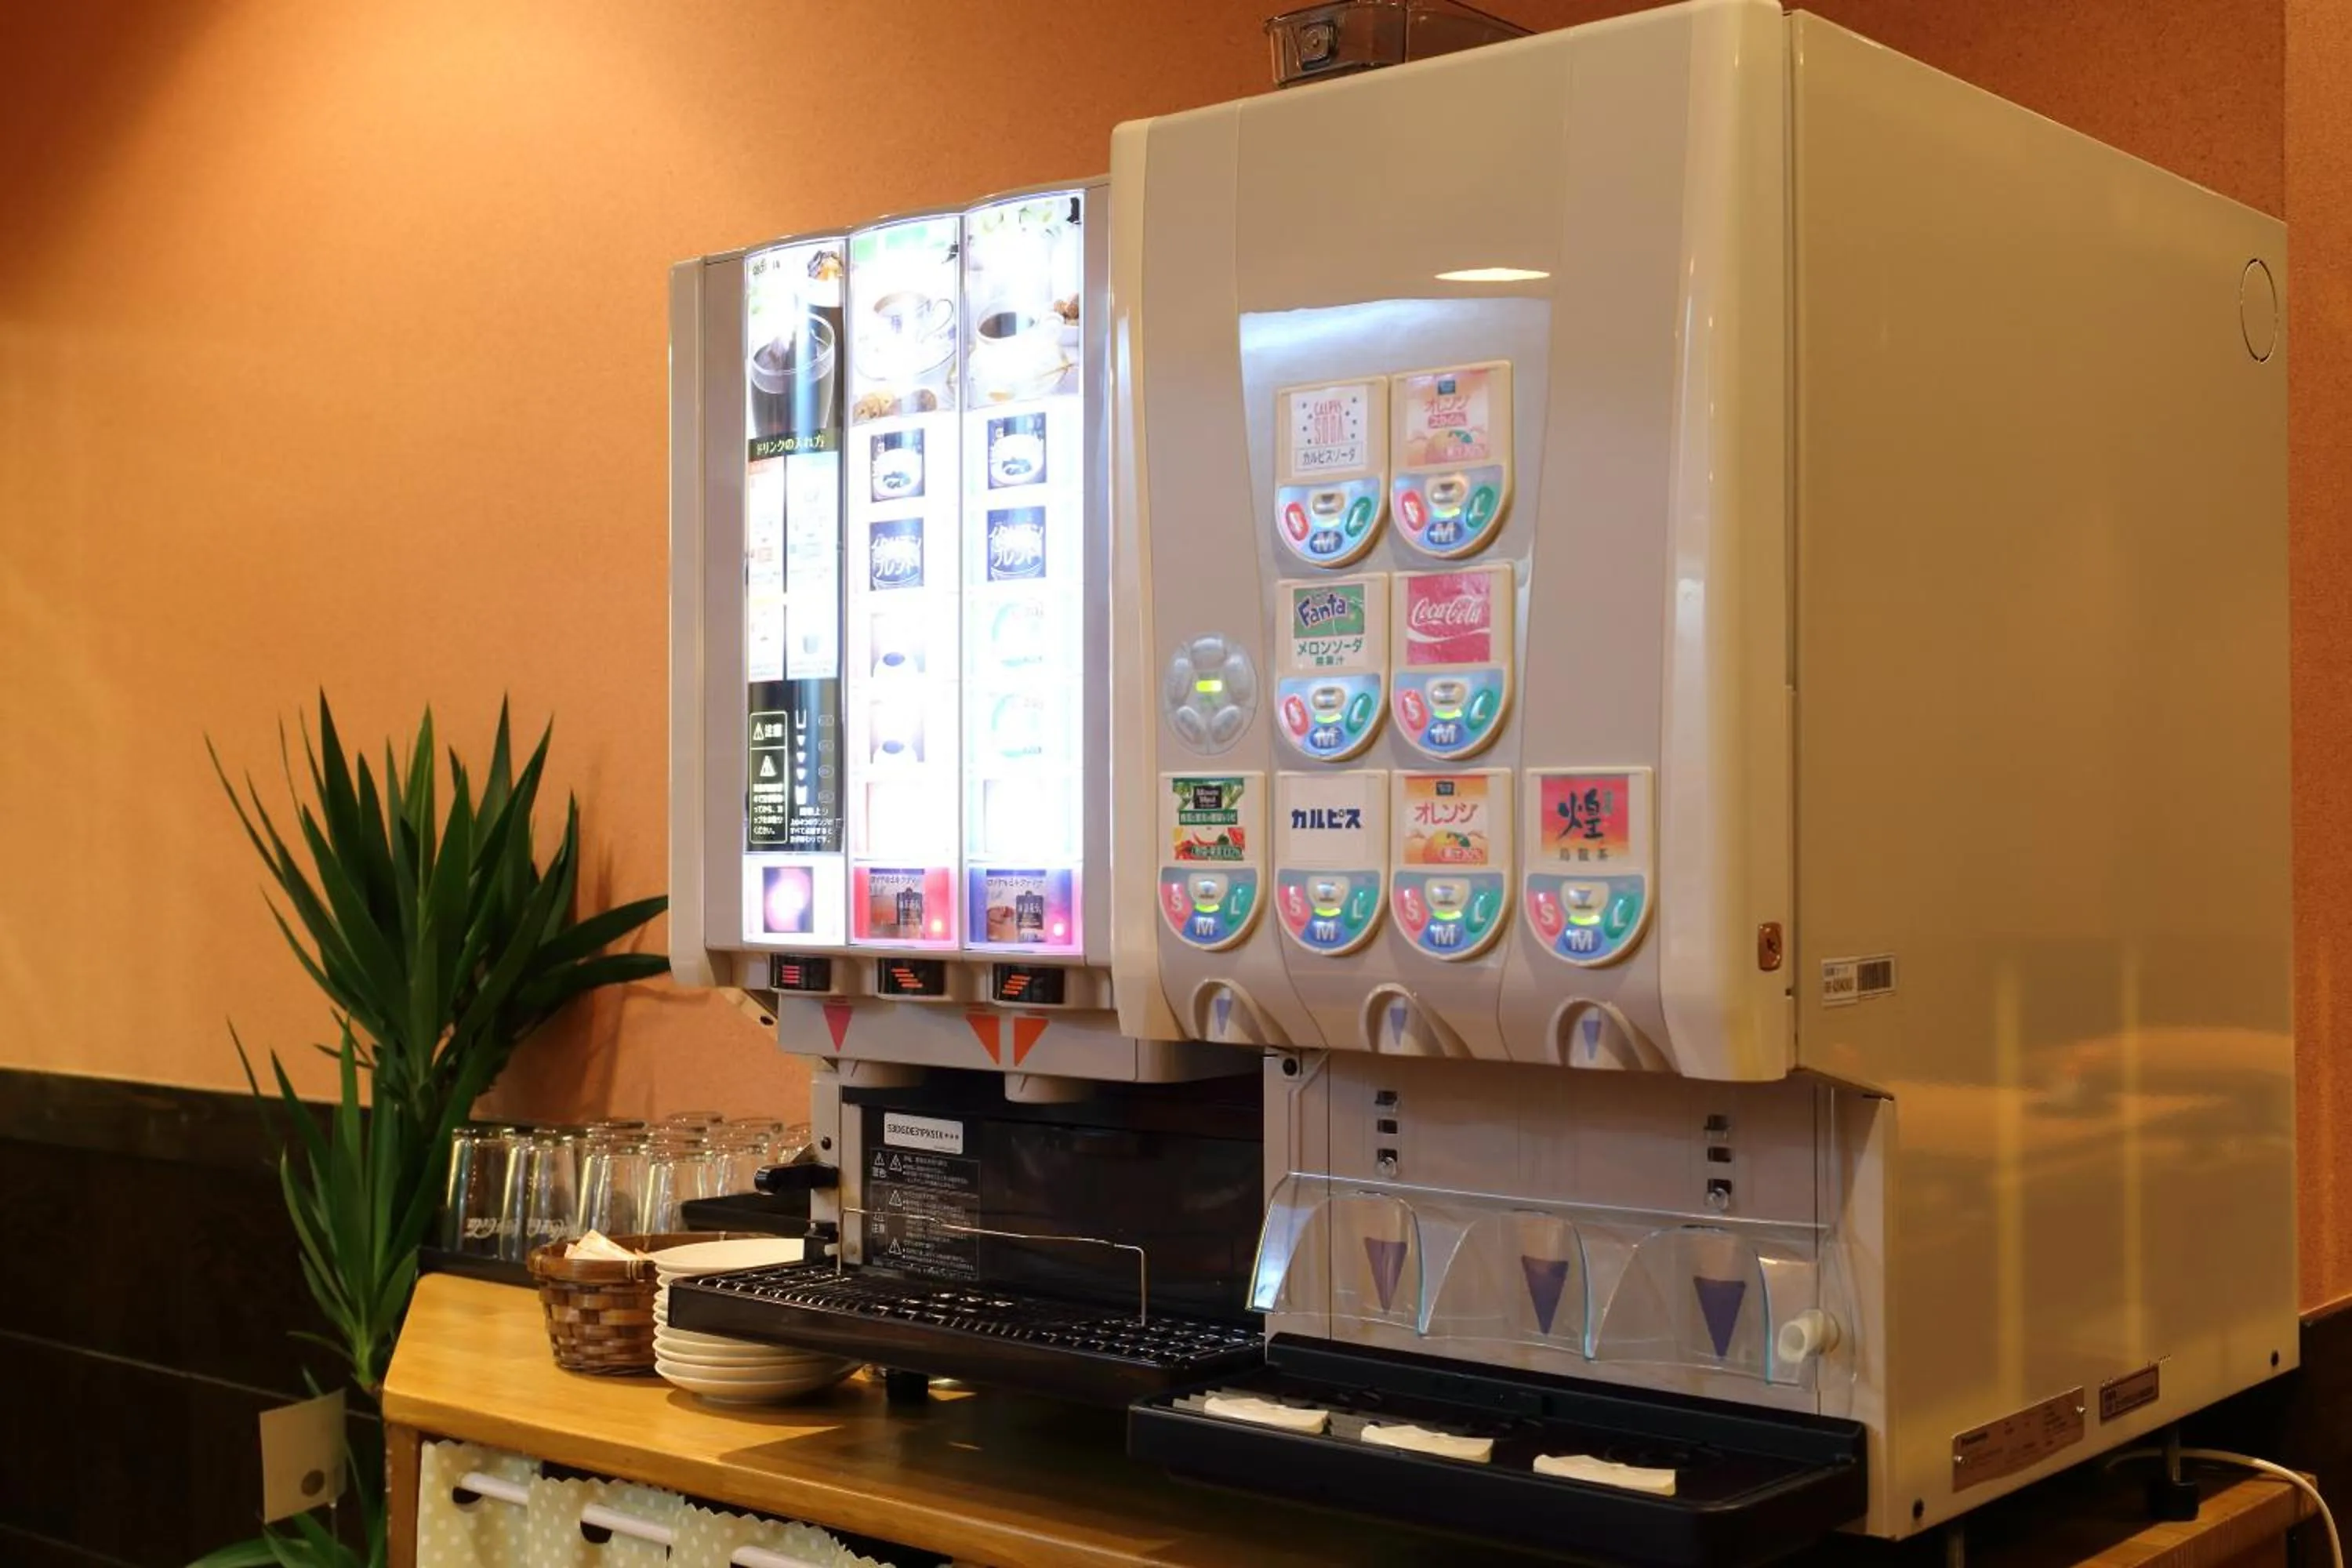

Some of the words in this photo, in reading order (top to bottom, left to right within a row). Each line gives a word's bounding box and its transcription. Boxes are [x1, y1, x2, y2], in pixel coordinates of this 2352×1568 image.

[1302, 448, 1356, 465] カルピスソーダ
[1297, 593, 1347, 627] Fanta
[1413, 597, 1480, 626] Coca-Cola
[1298, 637, 1363, 656] メロンソーダ
[1291, 808, 1361, 829] カルピス
[1414, 802, 1478, 824] オレンジ
